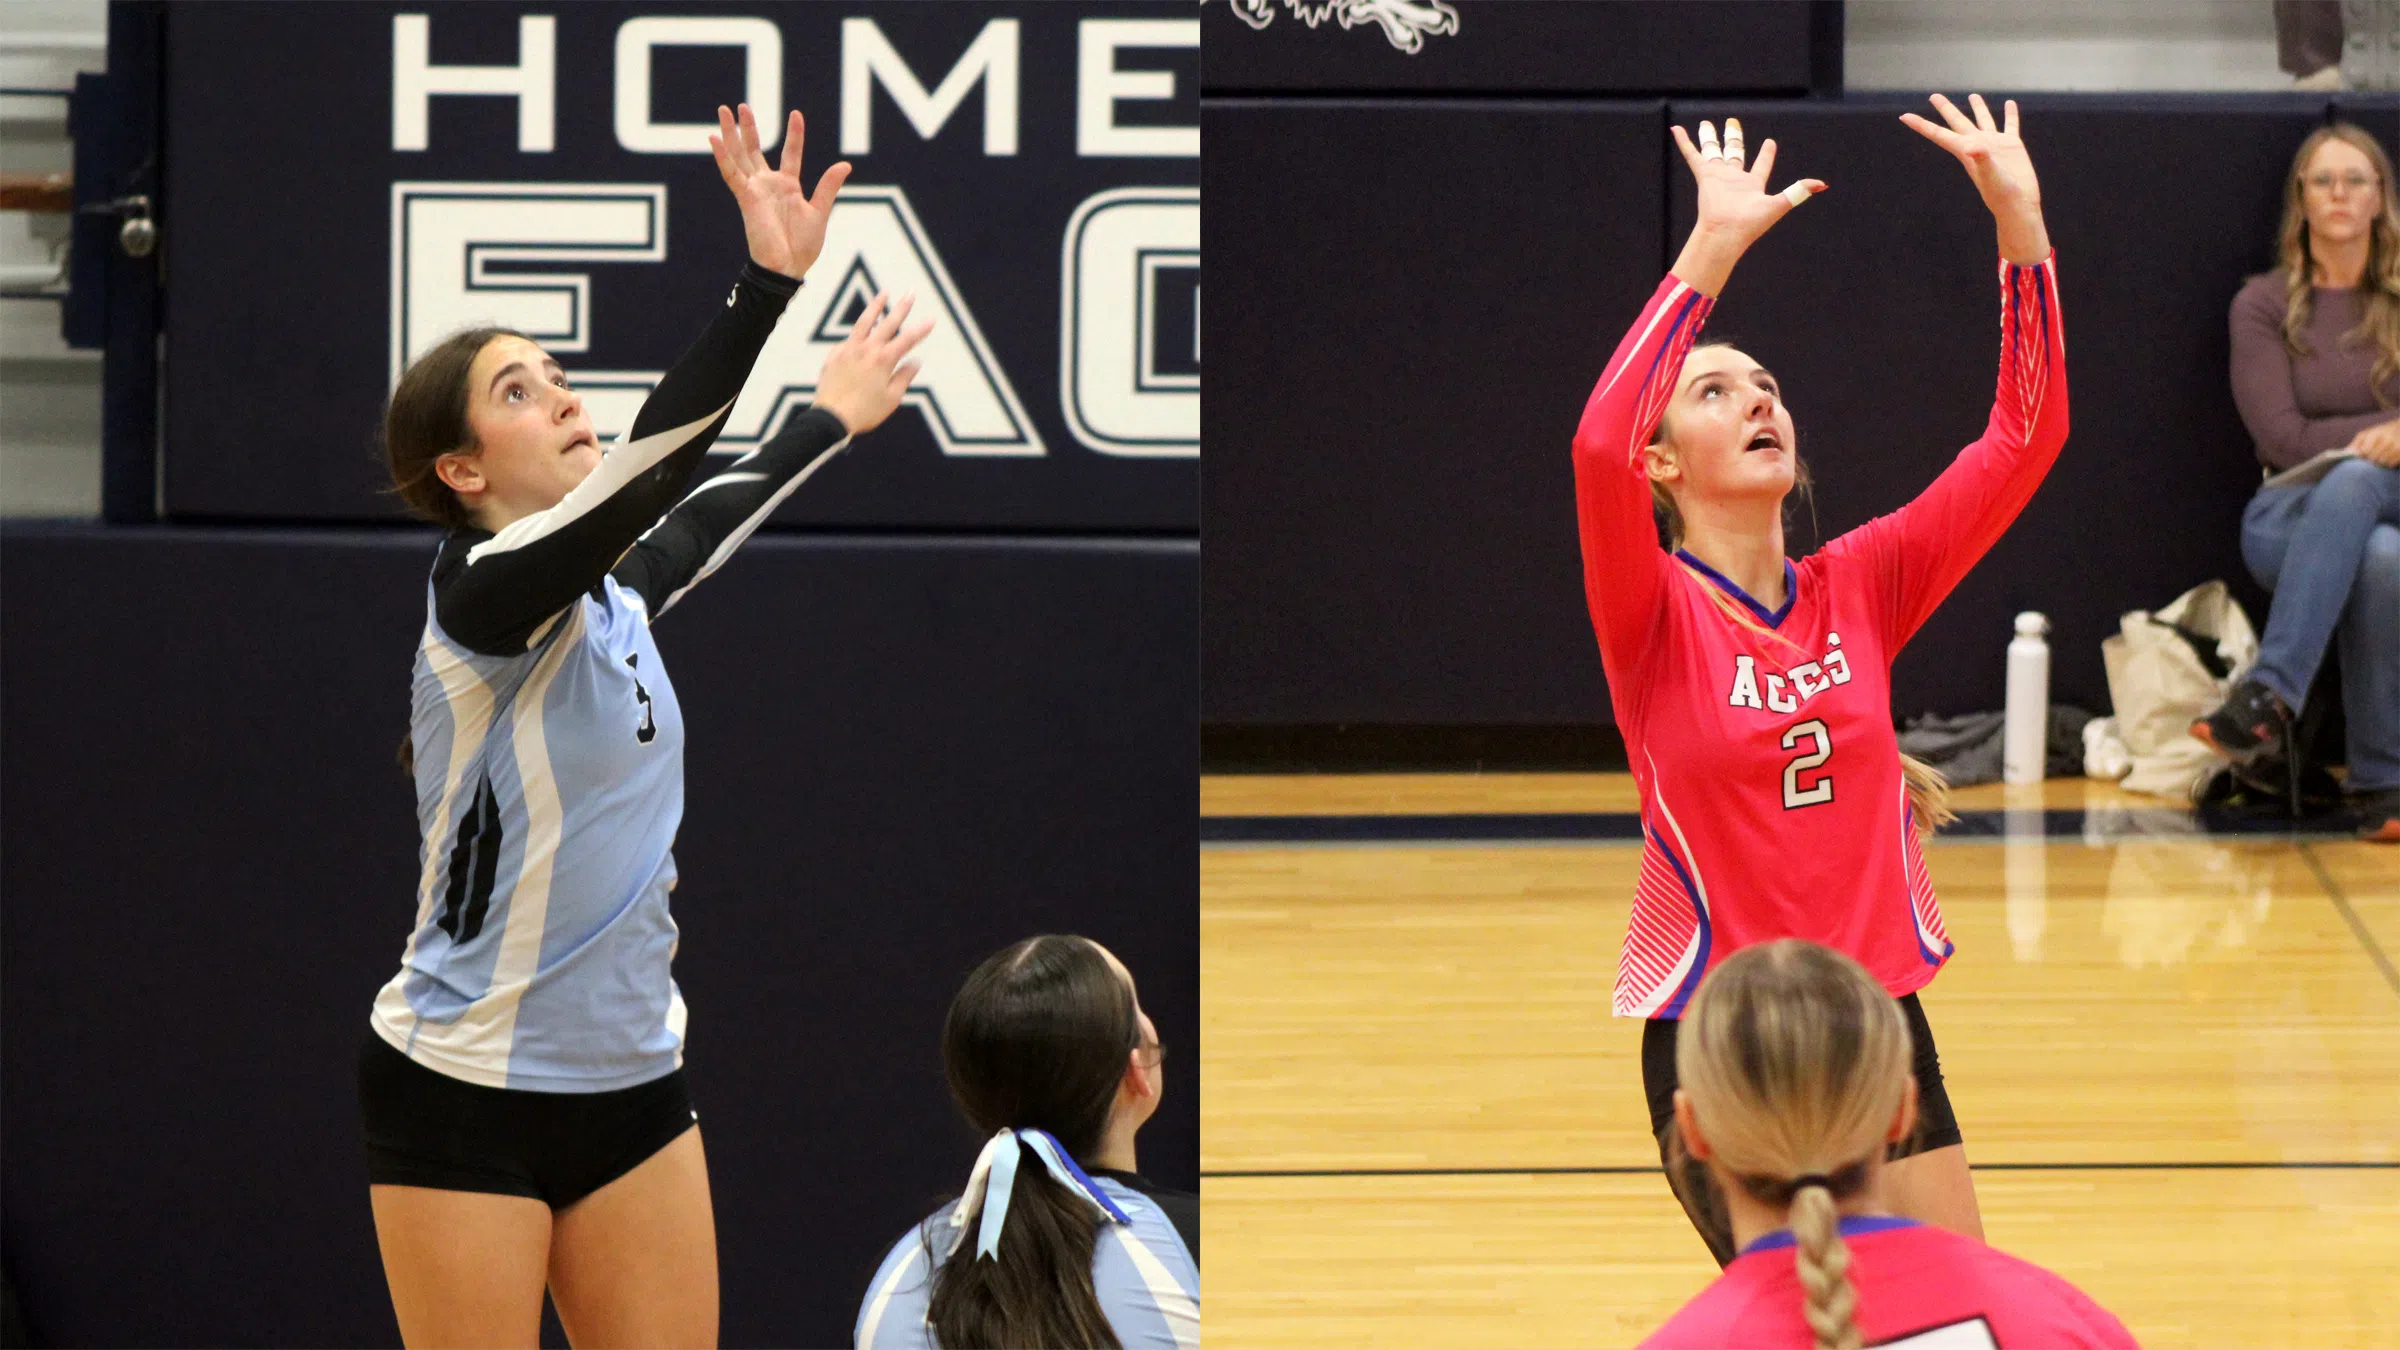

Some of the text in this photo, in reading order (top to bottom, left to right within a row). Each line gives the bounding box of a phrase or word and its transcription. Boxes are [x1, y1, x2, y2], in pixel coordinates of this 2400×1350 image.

[392, 14, 1200, 156] HOME
[1729, 631, 1852, 714] ACES
[1780, 717, 1834, 811] 2
